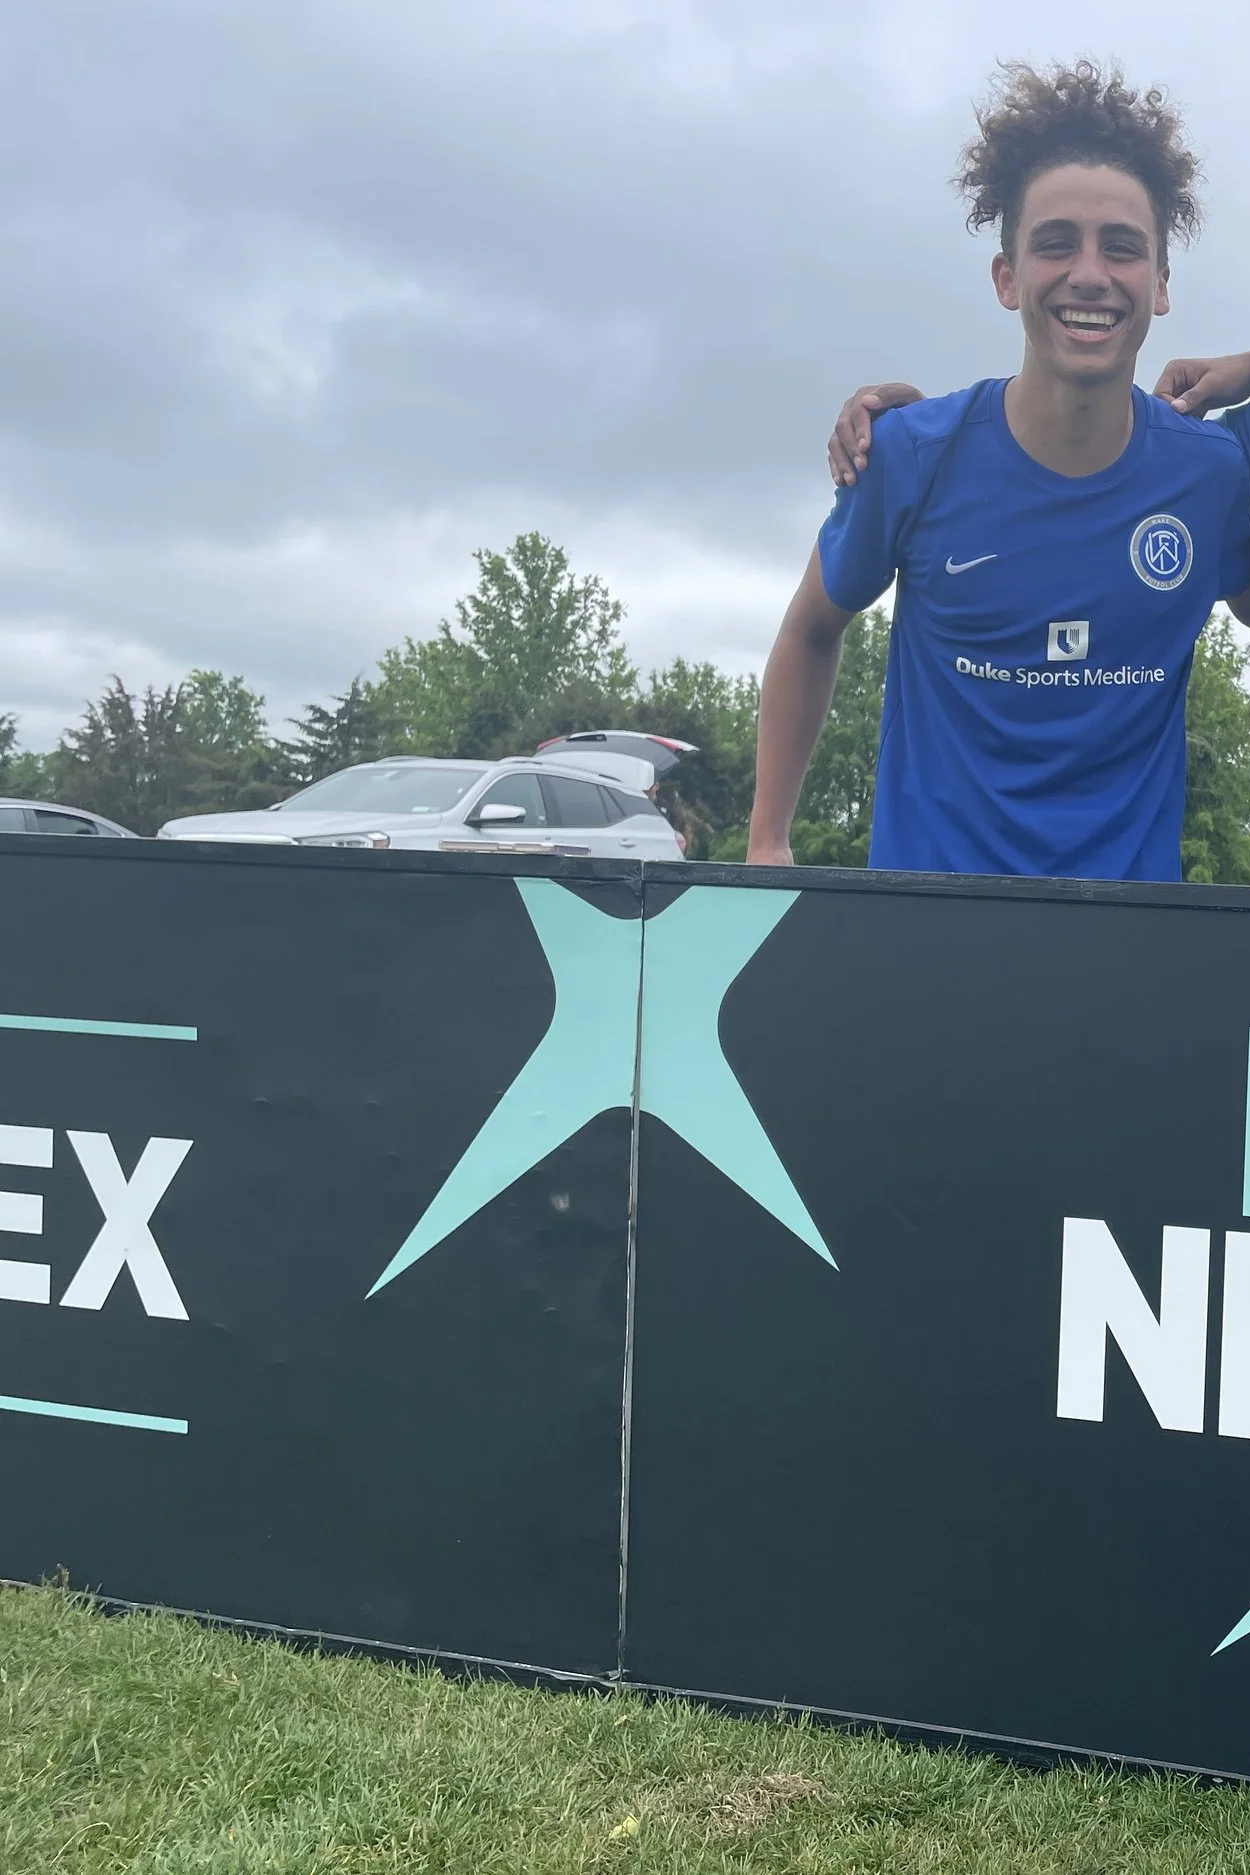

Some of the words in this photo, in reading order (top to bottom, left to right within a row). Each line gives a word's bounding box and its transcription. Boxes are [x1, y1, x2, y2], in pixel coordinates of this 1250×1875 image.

[955, 656, 1011, 682] Duke
[1015, 668, 1080, 688] Sports
[1083, 666, 1165, 686] Medicine
